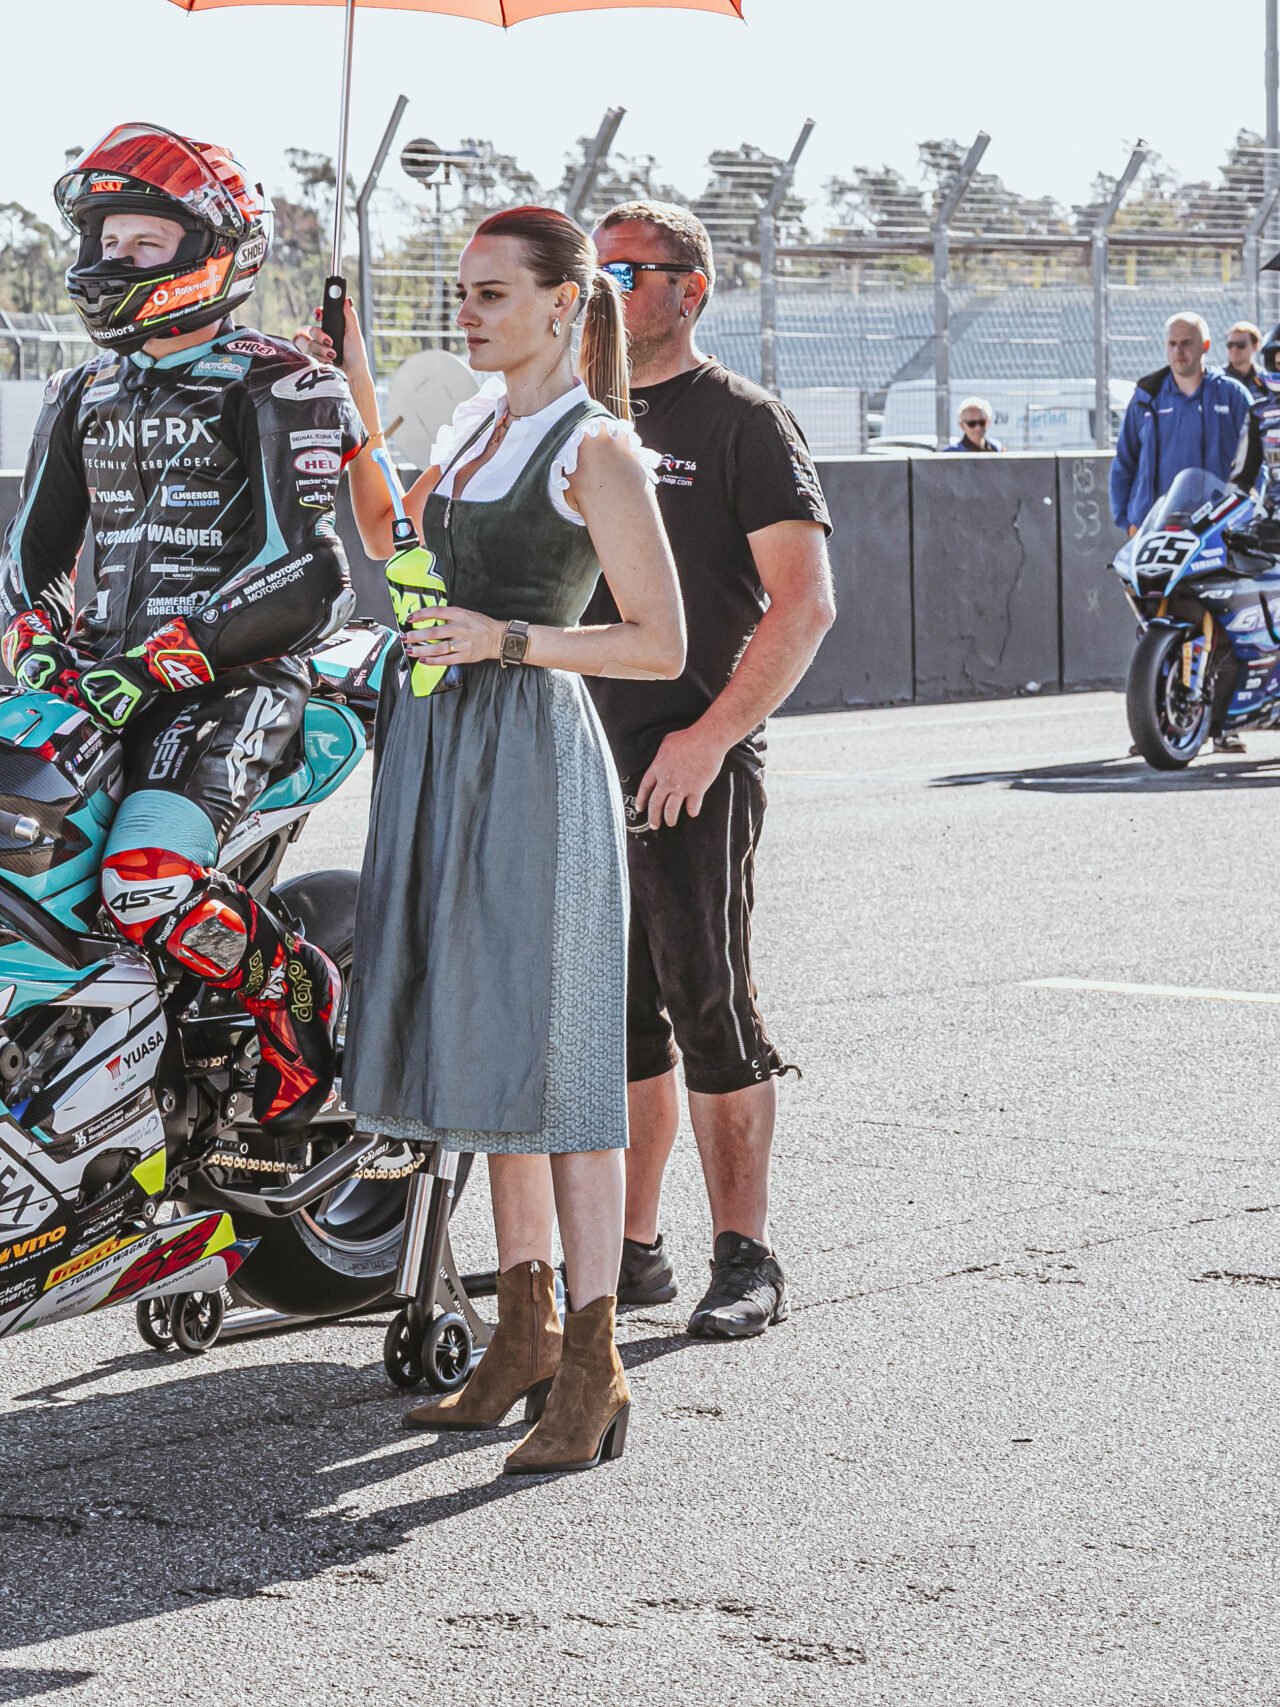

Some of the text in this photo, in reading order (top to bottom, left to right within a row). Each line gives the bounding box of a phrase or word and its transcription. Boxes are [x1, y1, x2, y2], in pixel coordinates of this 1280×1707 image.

[231, 341, 274, 355] SHOEI
[198, 360, 244, 375] MOTOREX
[84, 457, 127, 471] TECHNIK
[304, 459, 337, 470] HEL
[97, 489, 135, 503] YUASA
[103, 523, 223, 547] TOMMY WAGNER
[1073, 500, 1101, 540] S3
[1135, 535, 1196, 567] 65
[242, 552, 314, 597] BMW MOTORRAD
[246, 567, 306, 604] MOTORSPORT
[154, 913, 178, 946] POWER
[122, 1030, 165, 1070] YUASA
[87, 1109, 124, 1135] Maschinenbau
[124, 1104, 140, 1120] GmbH
[12, 1225, 67, 1258] VITO
[14, 1257, 29, 1267] FOR
[29, 1252, 43, 1262] THE
[42, 1241, 64, 1256] BRAVE
[51, 1238, 121, 1284] PIRELLI
[70, 1257, 111, 1287] TOMMY
[112, 1234, 159, 1265] WAGNER
[155, 1259, 213, 1292] Motorsport
